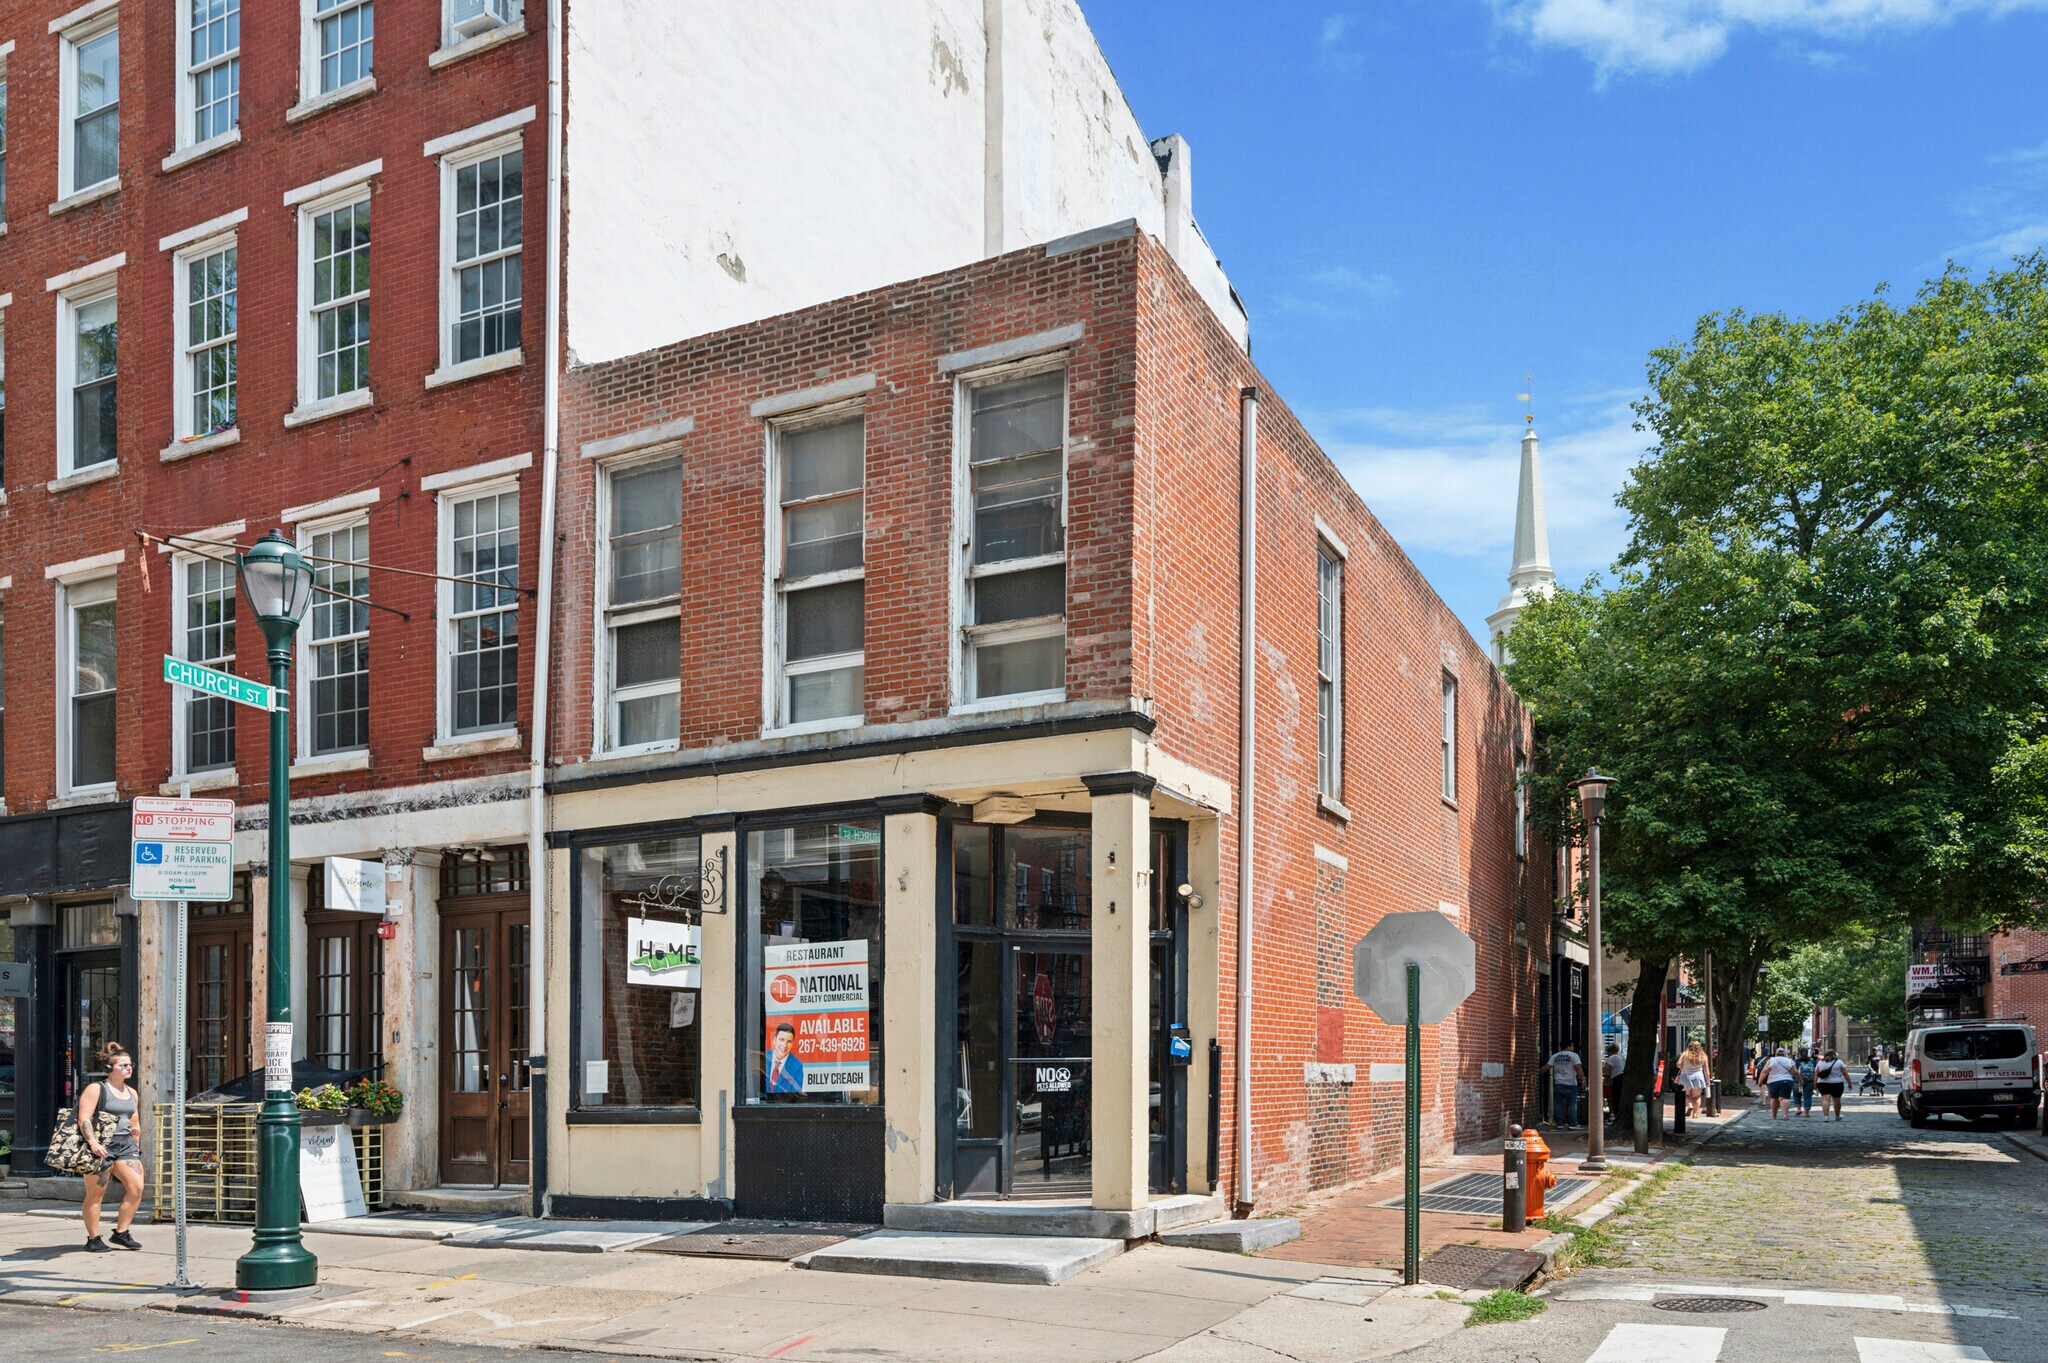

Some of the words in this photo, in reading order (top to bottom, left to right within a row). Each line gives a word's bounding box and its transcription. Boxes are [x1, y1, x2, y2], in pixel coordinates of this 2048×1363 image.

[168, 661, 240, 698] CHURCH
[246, 688, 261, 704] ST
[136, 815, 152, 825] NO
[157, 816, 215, 826] STOPPING
[175, 846, 217, 854] RESERVED
[164, 855, 170, 863] 2
[174, 855, 186, 863] HR
[189, 855, 227, 864] PARKING
[786, 946, 845, 962] RESTAURANT
[800, 973, 863, 993] NATIONAL
[800, 994, 822, 1003] REALTY
[823, 993, 864, 1002] COMMERCIAL
[799, 1017, 865, 1035] AVAILABLE
[798, 1037, 865, 1053] 267-439-6926
[807, 1073, 830, 1085] BILLY
[830, 1072, 864, 1085] CREAGH
[1036, 1067, 1056, 1083] NO
[1928, 1070, 1974, 1079] WM.PROUD
